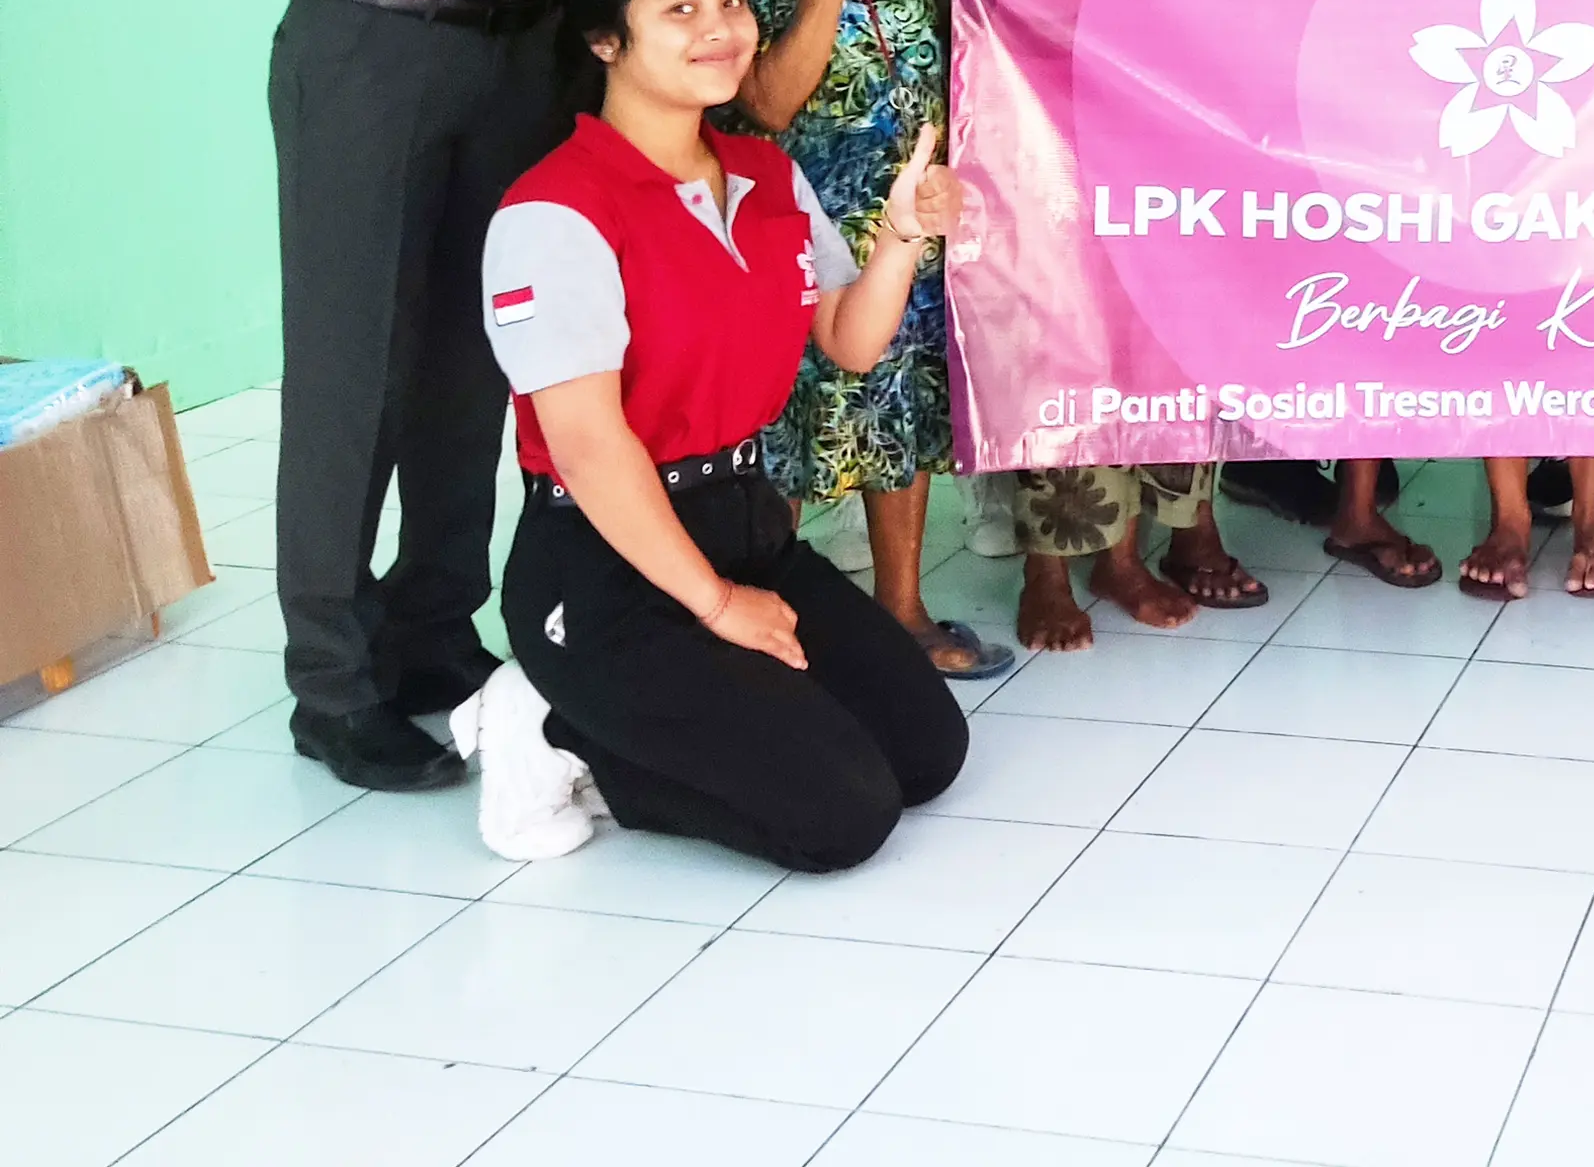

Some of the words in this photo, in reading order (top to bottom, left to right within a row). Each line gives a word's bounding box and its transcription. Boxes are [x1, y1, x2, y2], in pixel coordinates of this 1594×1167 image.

[1094, 185, 1226, 238] LPK
[1242, 189, 1452, 243] HOSHI
[1275, 271, 1507, 355] Berbagi
[1039, 388, 1077, 426] di
[1092, 383, 1208, 425] Panti
[1217, 382, 1345, 421] Sosial
[1355, 381, 1493, 419] Tresna
